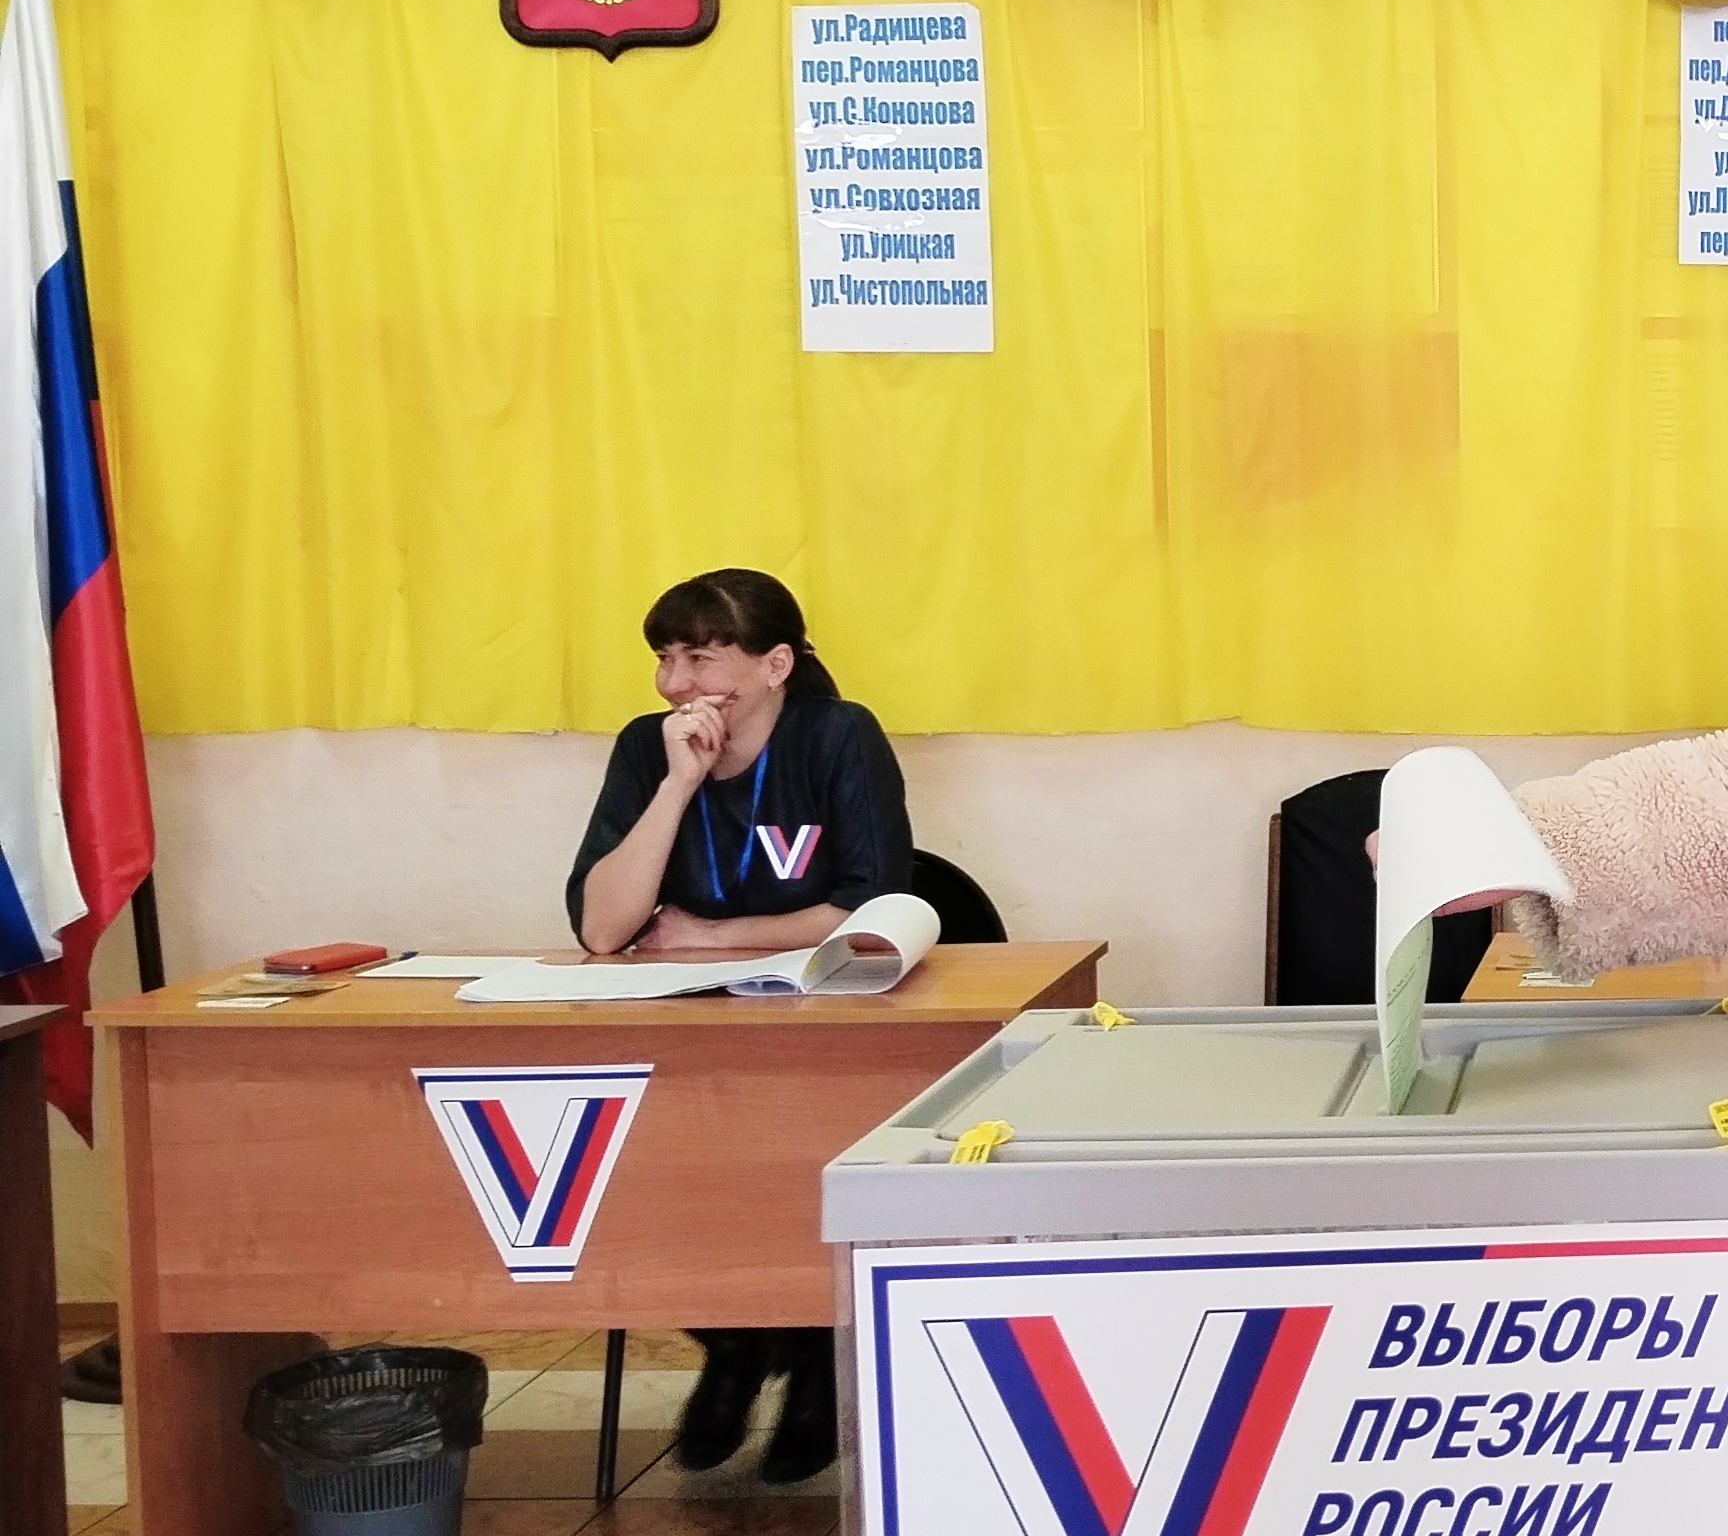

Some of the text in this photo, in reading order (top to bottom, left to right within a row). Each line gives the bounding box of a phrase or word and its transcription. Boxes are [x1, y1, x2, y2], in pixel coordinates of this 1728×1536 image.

[811, 13, 967, 45] ул.Радищева
[801, 56, 979, 87] пер.Романцова
[805, 144, 983, 173] ул.Романцова
[810, 183, 981, 214] ул.Совхозная
[840, 232, 955, 264] ул.Урицкая
[810, 274, 988, 307] ул.Чистопольная
[1369, 1294, 1718, 1371] ВЫБОРЫ
